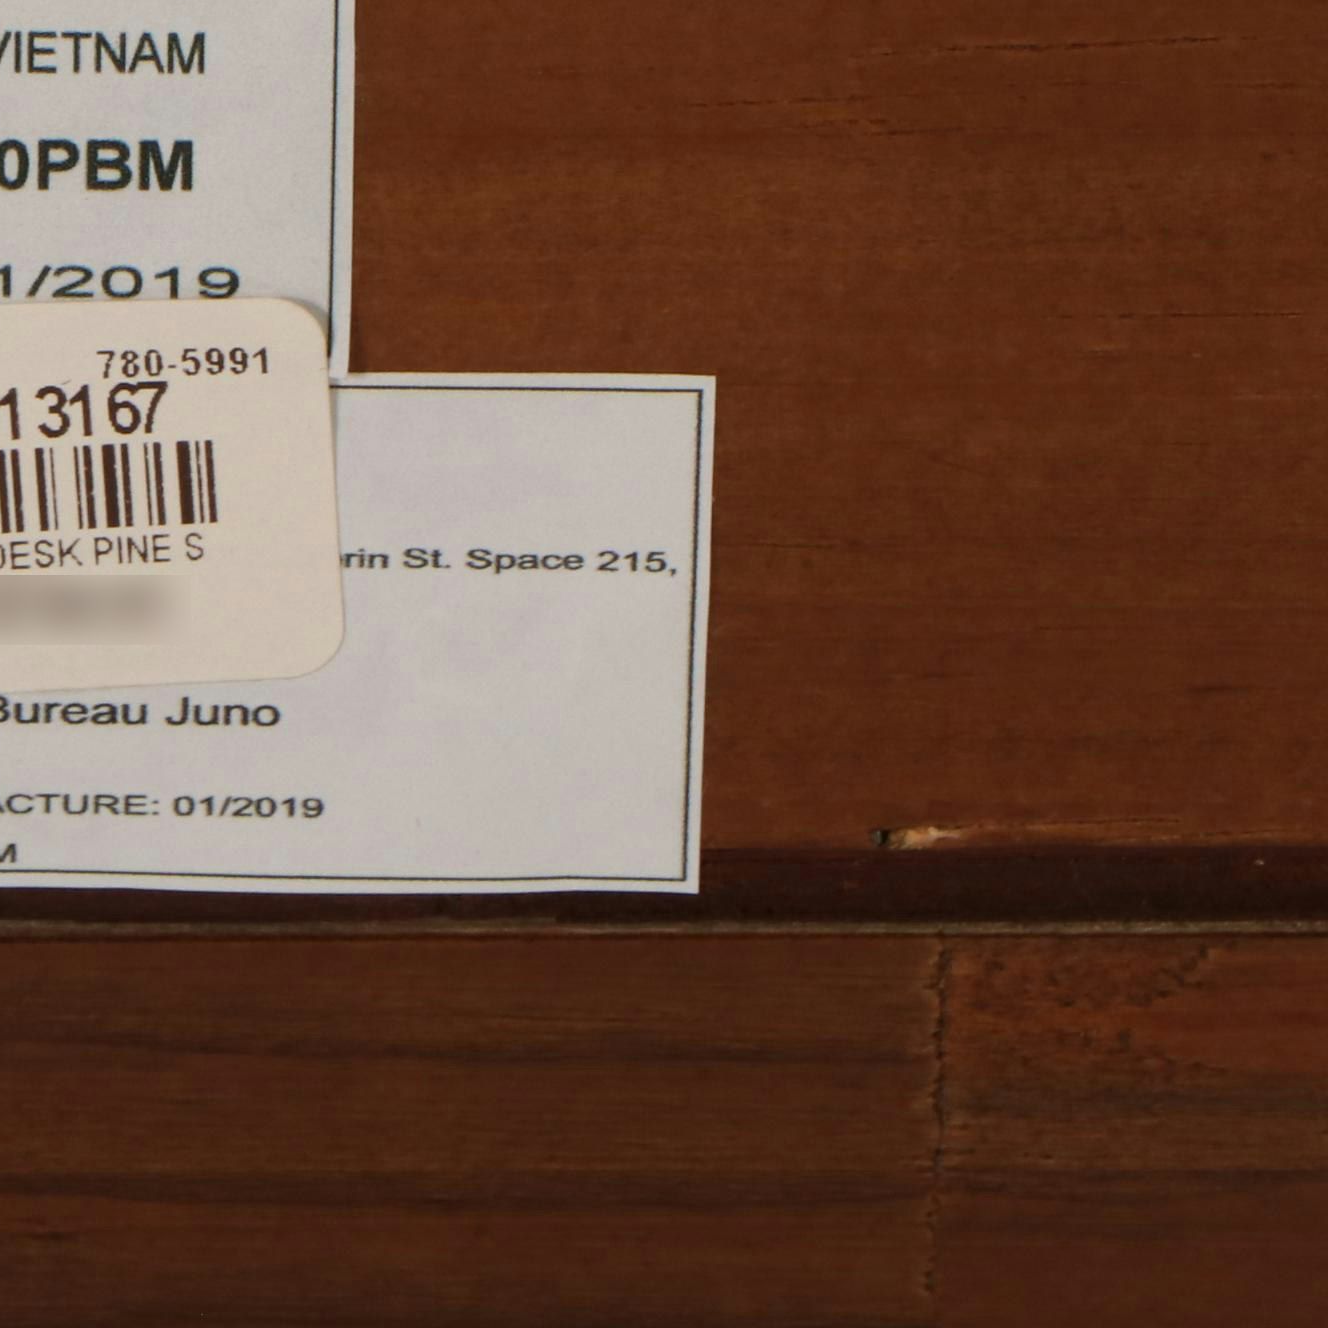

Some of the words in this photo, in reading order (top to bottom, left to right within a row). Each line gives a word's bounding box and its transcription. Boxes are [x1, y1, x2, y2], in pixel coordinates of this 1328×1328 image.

[95, 346, 271, 379] 780-5991
[93, 533, 171, 566] PINE
[184, 531, 205, 562] S
[340, 548, 389, 569] rin
[402, 547, 452, 570] St.
[465, 548, 585, 575] Space
[596, 550, 677, 577] 215,
[164, 696, 281, 728] Juno
[172, 795, 325, 819] 01/2019
